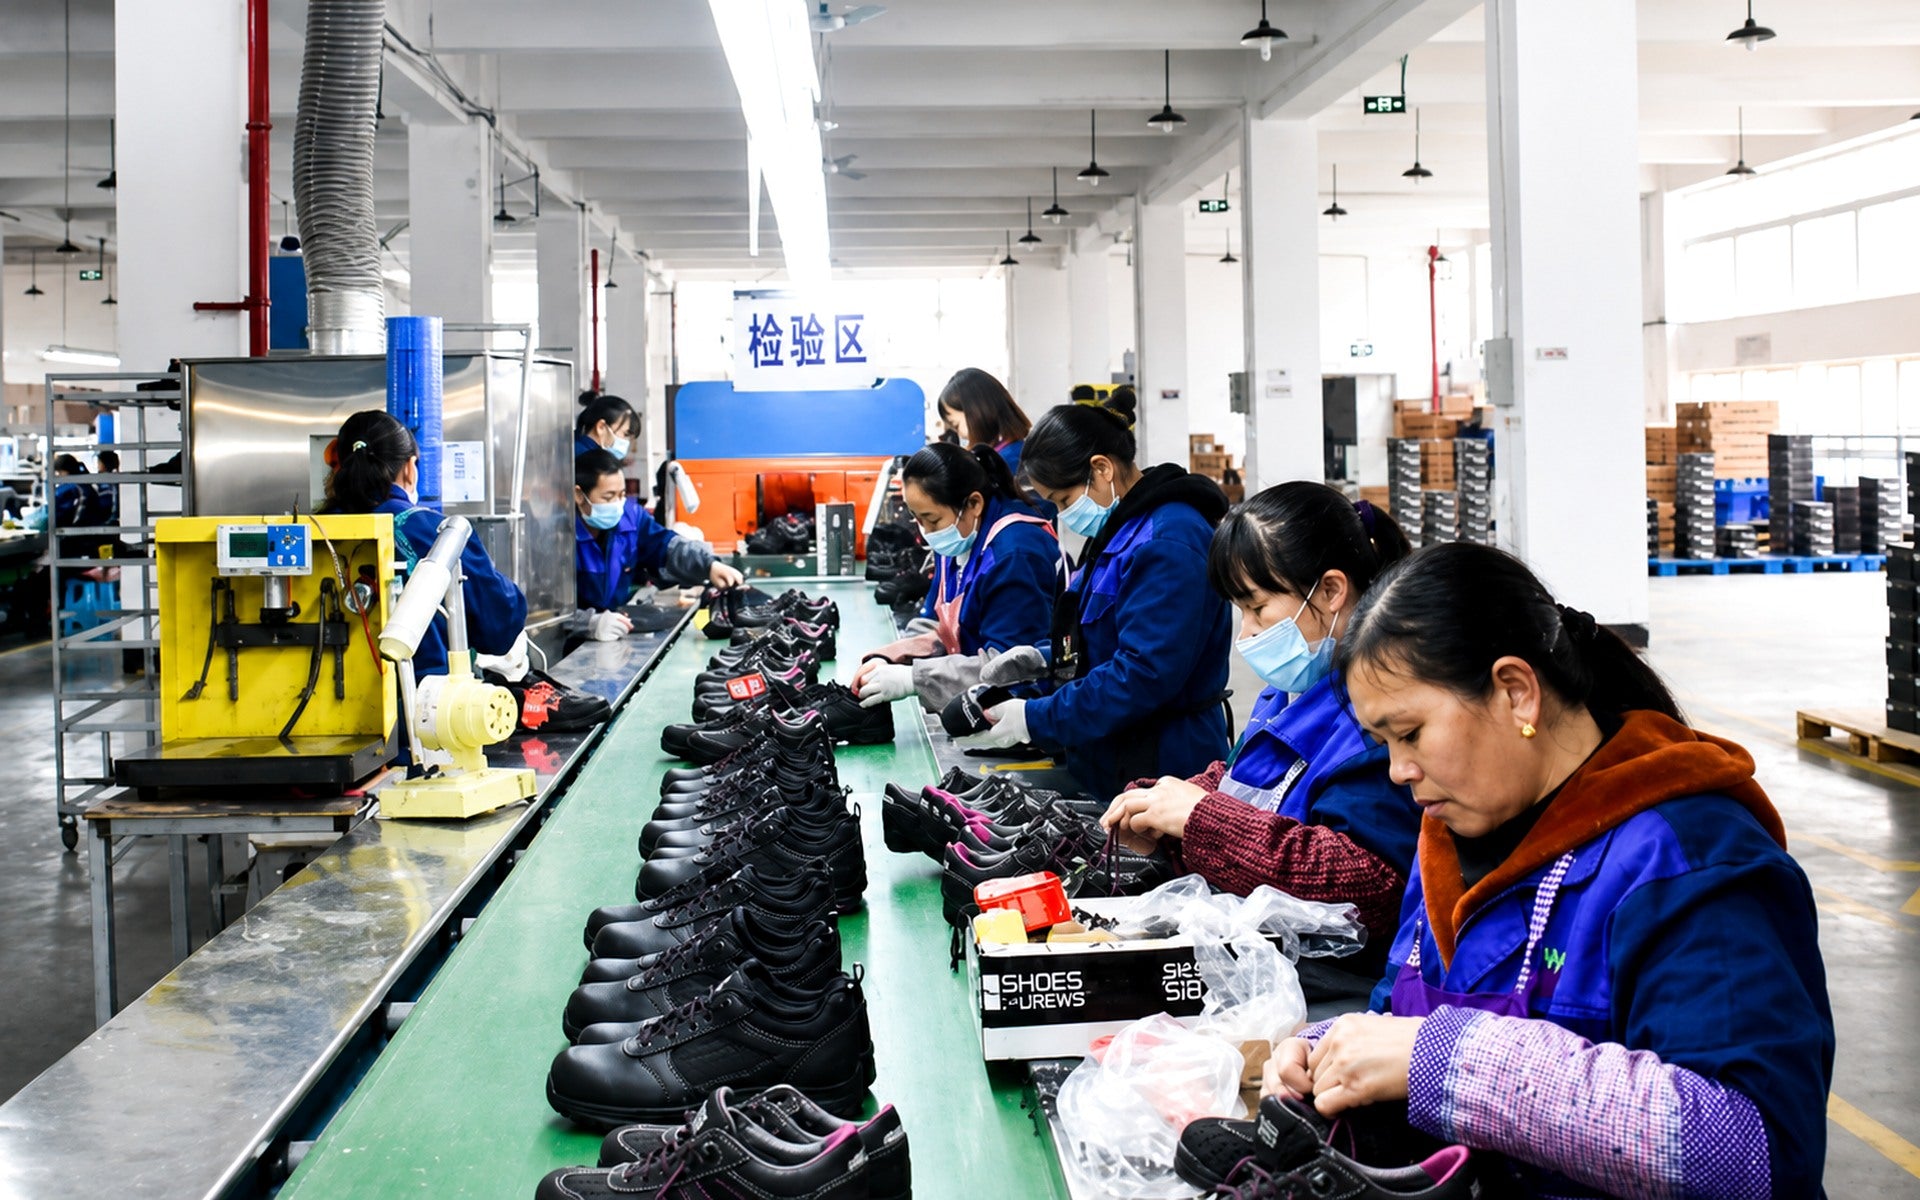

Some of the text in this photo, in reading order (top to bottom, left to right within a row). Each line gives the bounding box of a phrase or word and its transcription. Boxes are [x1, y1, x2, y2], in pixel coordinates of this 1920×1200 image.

[748, 313, 867, 368] 检验区
[1001, 971, 1083, 993] SHOES
